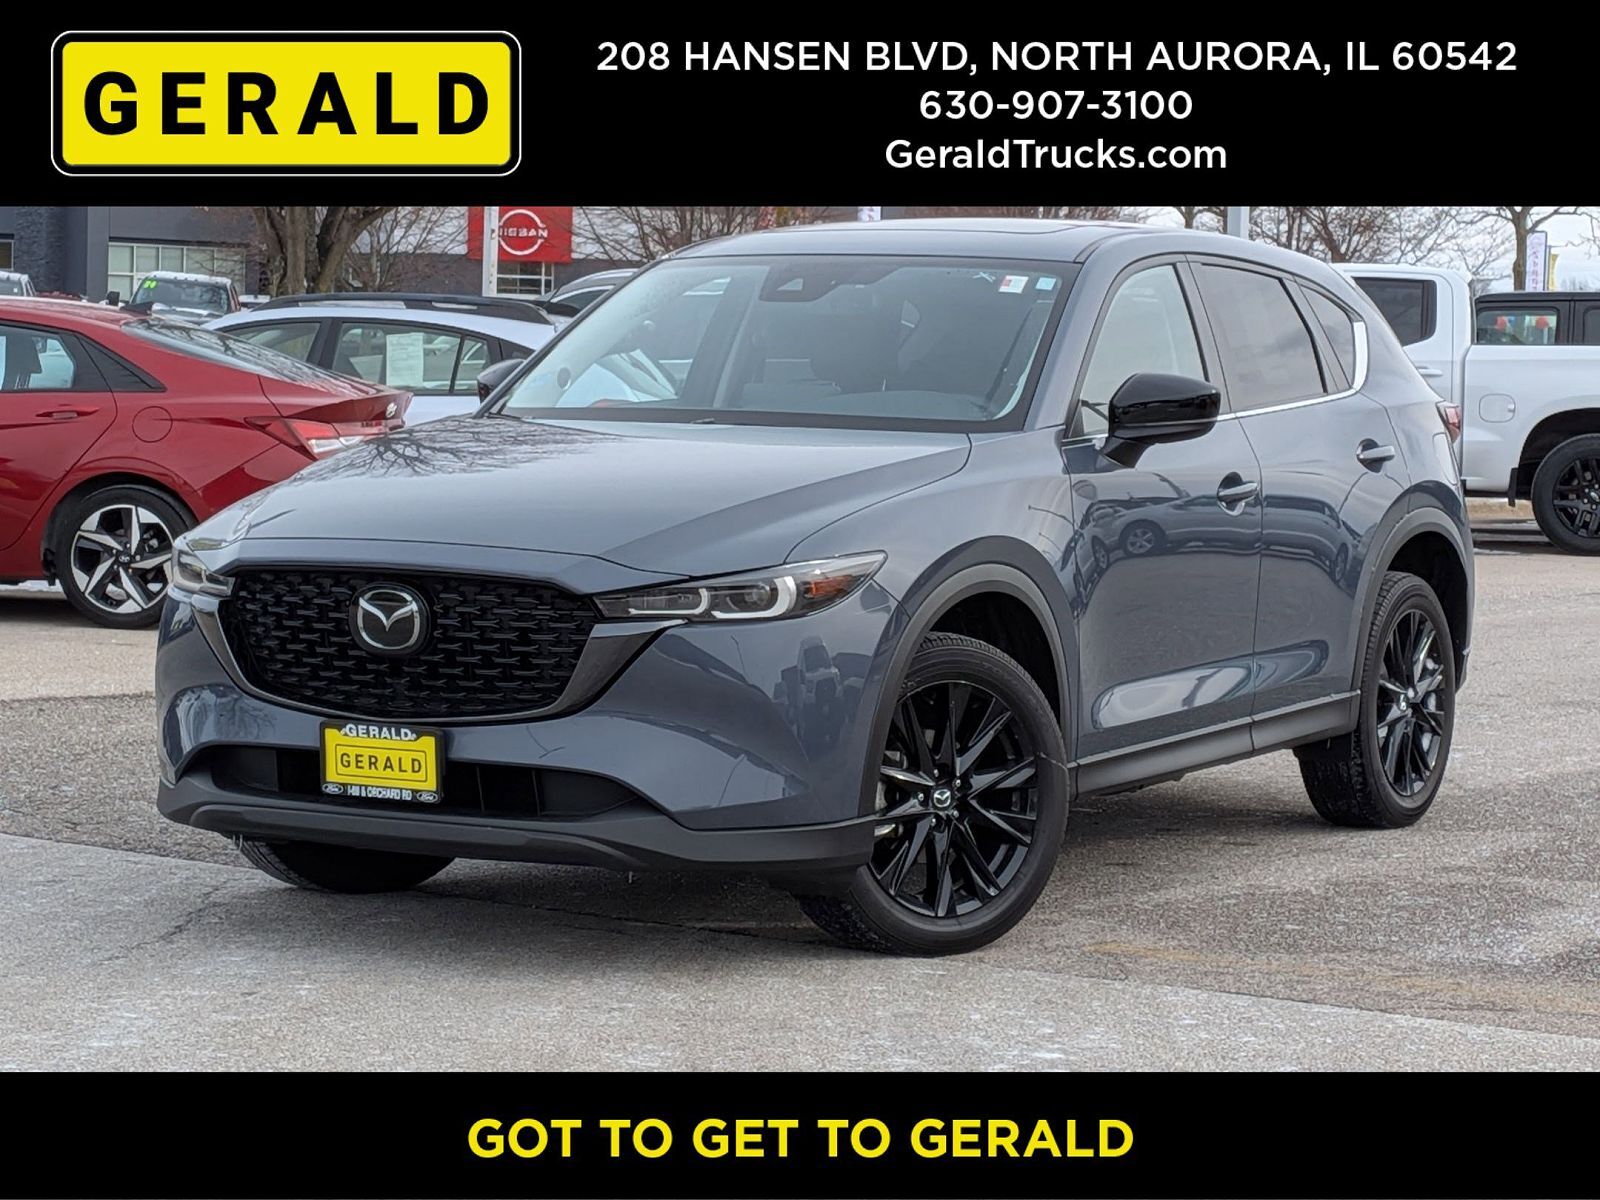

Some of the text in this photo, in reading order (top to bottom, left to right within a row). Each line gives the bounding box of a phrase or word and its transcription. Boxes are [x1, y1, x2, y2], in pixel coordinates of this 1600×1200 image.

[499, 227, 548, 238] ISSAN
[345, 723, 411, 741] GERALD
[340, 752, 422, 774] GERALD
